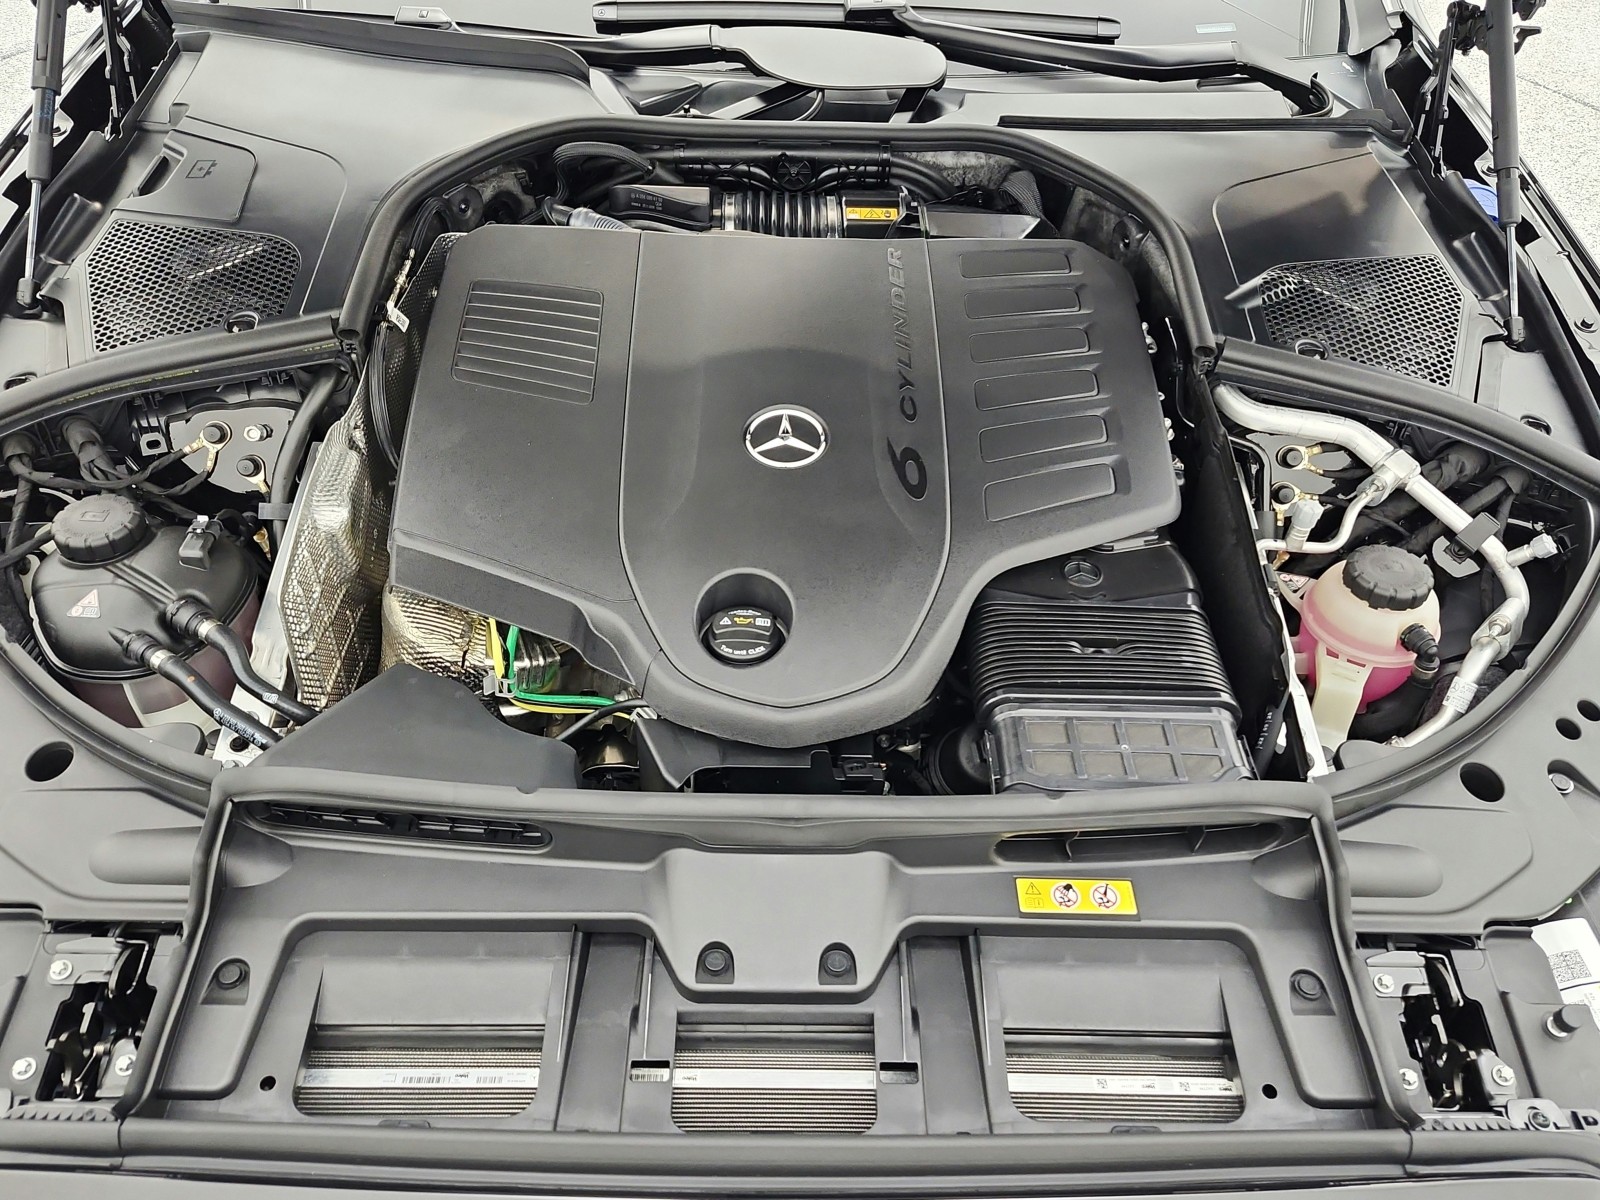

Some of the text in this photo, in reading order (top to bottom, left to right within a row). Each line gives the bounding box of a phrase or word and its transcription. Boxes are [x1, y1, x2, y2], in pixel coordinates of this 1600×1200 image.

[886, 247, 928, 501] 6 CYLINDER
[720, 645, 733, 654] Turn
[747, 646, 766, 655] CLICK
